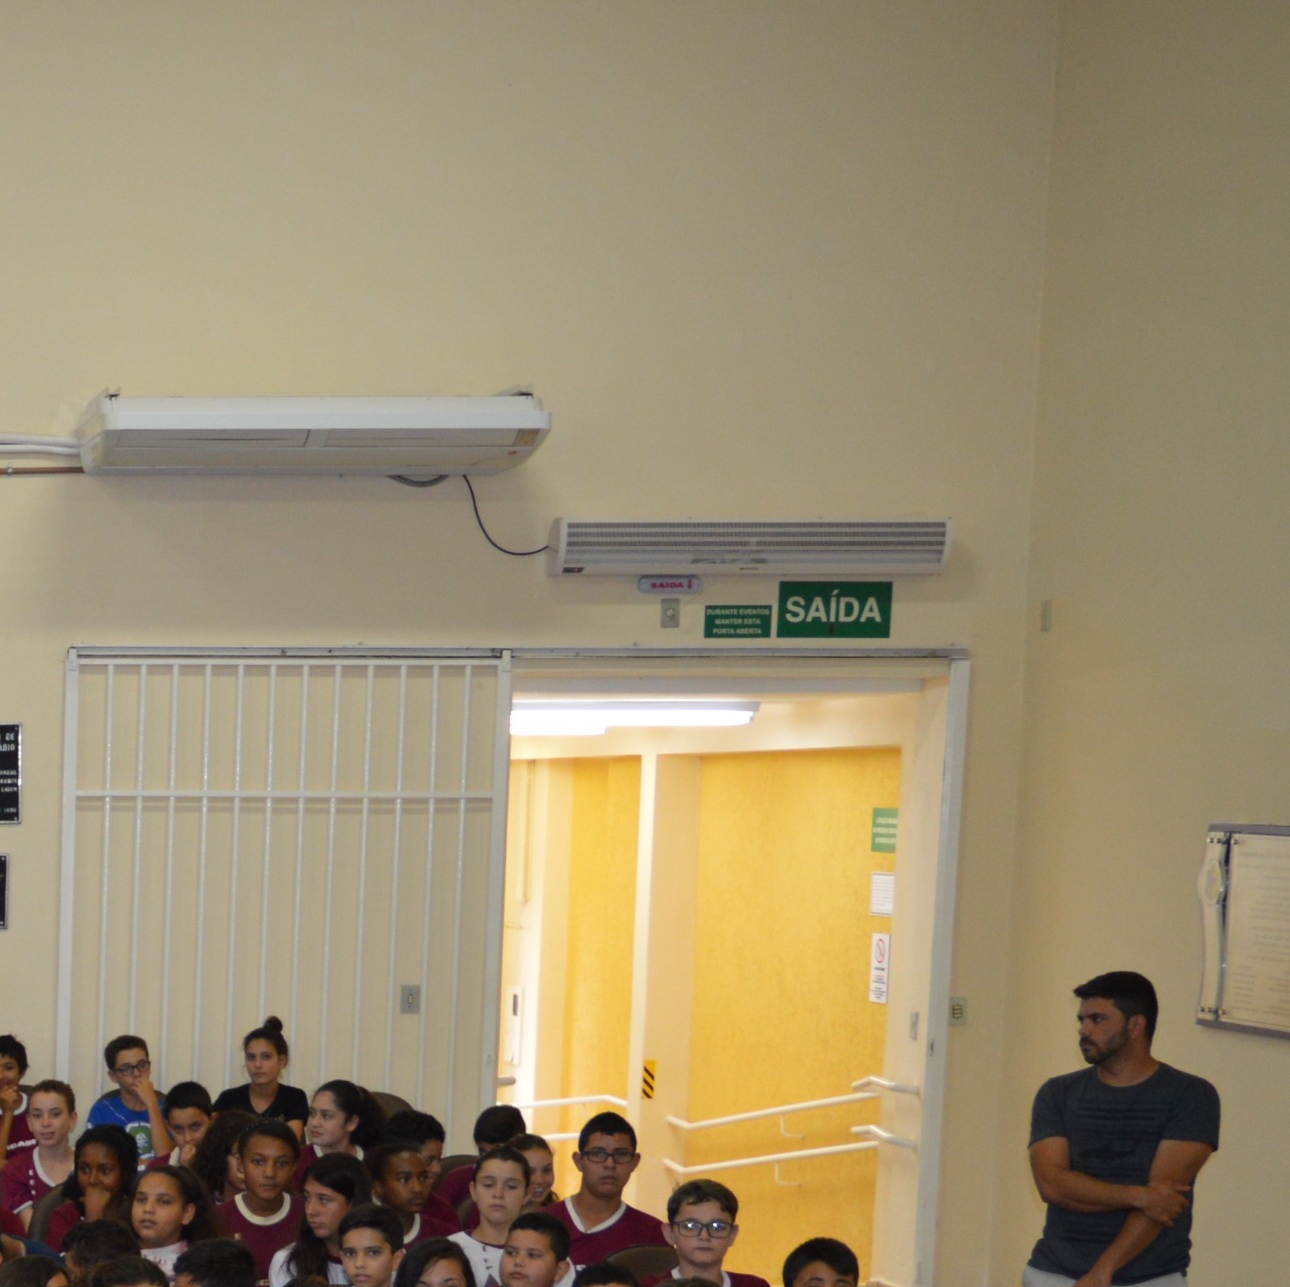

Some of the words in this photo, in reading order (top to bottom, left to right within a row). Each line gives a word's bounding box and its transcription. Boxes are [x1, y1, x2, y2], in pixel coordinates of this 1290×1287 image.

[650, 580, 684, 589] SAÍDA
[785, 589, 883, 623] SAÍDA
[706, 608, 737, 616] DURANTE
[739, 608, 770, 616] EVENTOS
[713, 627, 736, 635] PORTA
[737, 627, 763, 635] ABERTA
